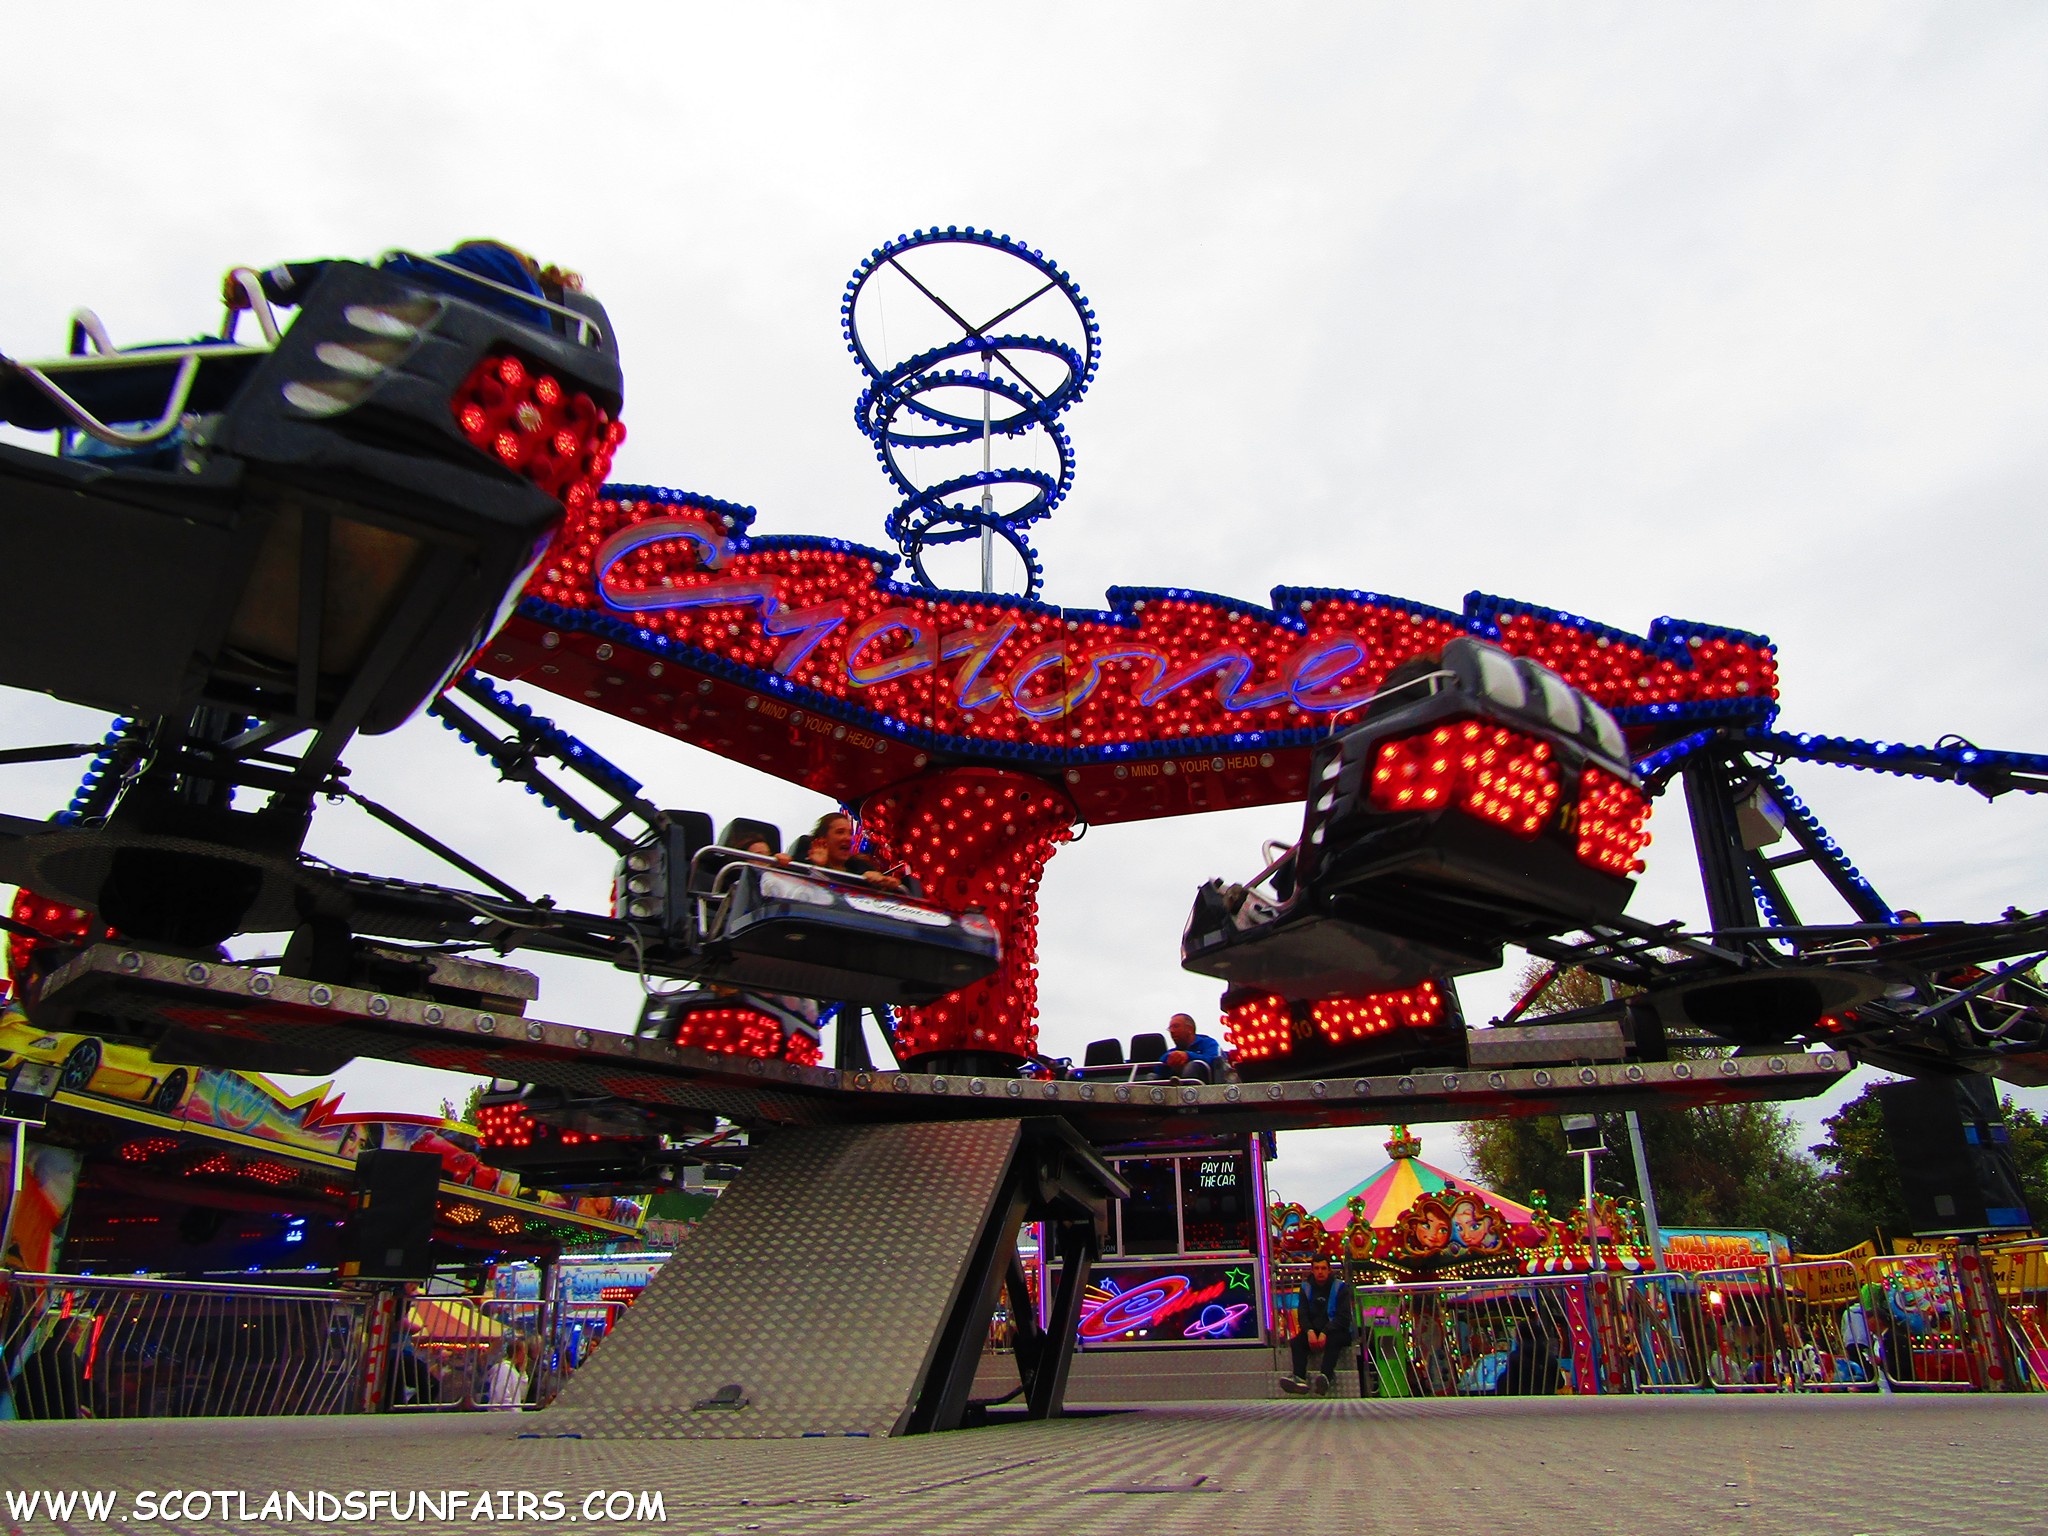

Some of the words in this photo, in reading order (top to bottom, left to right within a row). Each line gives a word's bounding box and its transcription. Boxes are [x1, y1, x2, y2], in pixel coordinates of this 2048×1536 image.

[759, 701, 788, 719] MIND
[804, 716, 833, 735] YOUR
[847, 731, 874, 749] HEAD
[1131, 764, 1159, 777] MIND
[1179, 759, 1210, 774] YOUR
[1227, 755, 1258, 769] HEAD
[1560, 802, 1579, 834] 11
[1291, 1019, 1313, 1040] 10
[1200, 1161, 1220, 1174] PAY
[1221, 1161, 1234, 1173] IN
[1200, 1175, 1216, 1187] THE
[1216, 1174, 1236, 1186] CAR
[1669, 1236, 1706, 1254] HULL
[1706, 1235, 1752, 1255] FAIR'S
[1906, 1243, 1931, 1253] BIG
[1727, 1255, 1769, 1269] GAME
